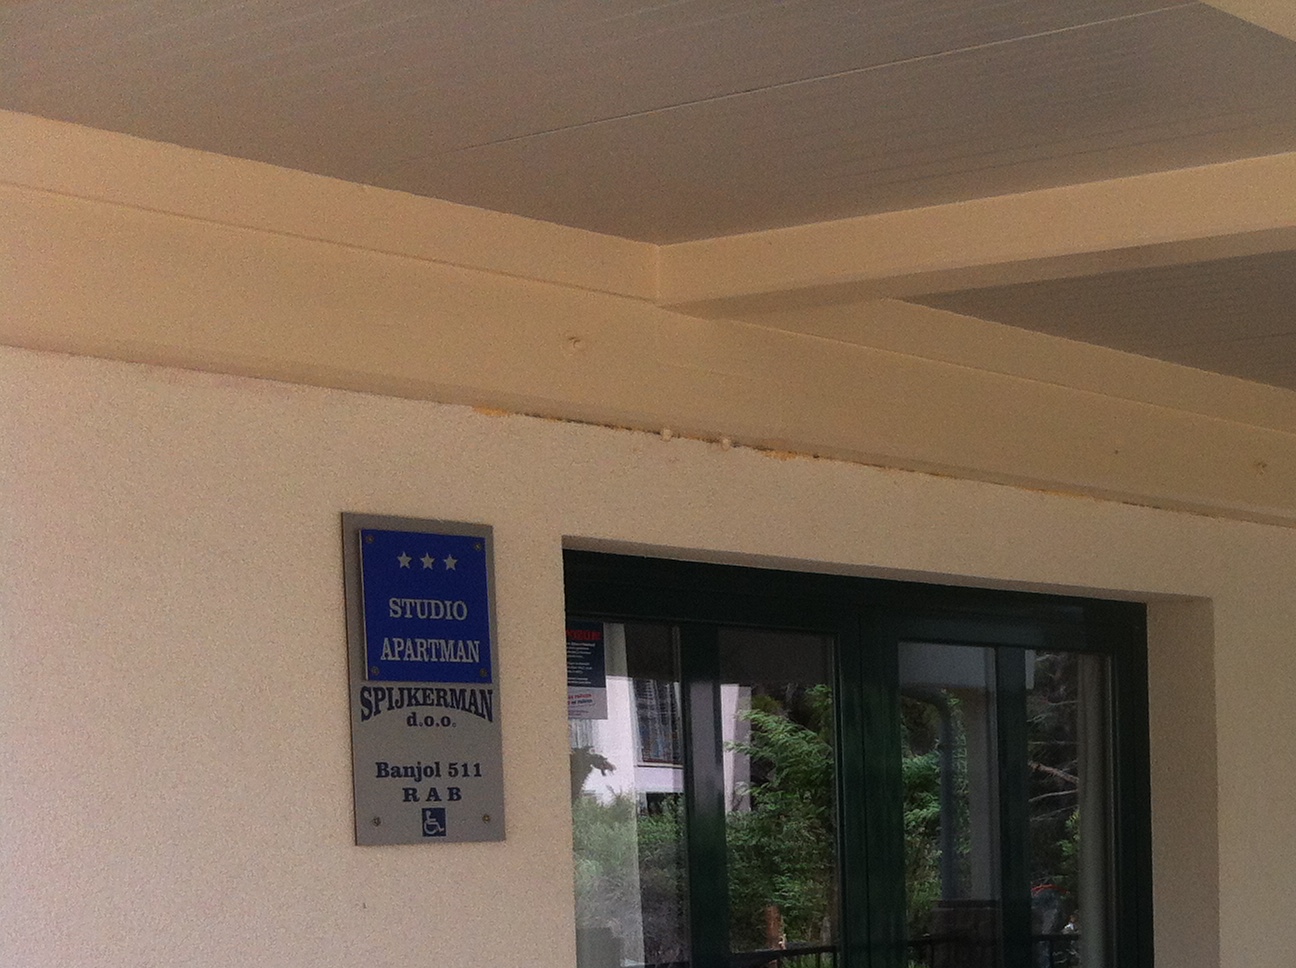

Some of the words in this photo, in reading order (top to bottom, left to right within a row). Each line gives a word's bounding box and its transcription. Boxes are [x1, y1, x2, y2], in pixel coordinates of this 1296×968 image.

[389, 598, 468, 620] STUDIO
[381, 637, 480, 662] APARTMAN
[360, 686, 493, 722] SPIJKERMAN
[406, 712, 457, 728] d.o.o.
[375, 762, 441, 781] Banjol
[448, 762, 482, 778] 511
